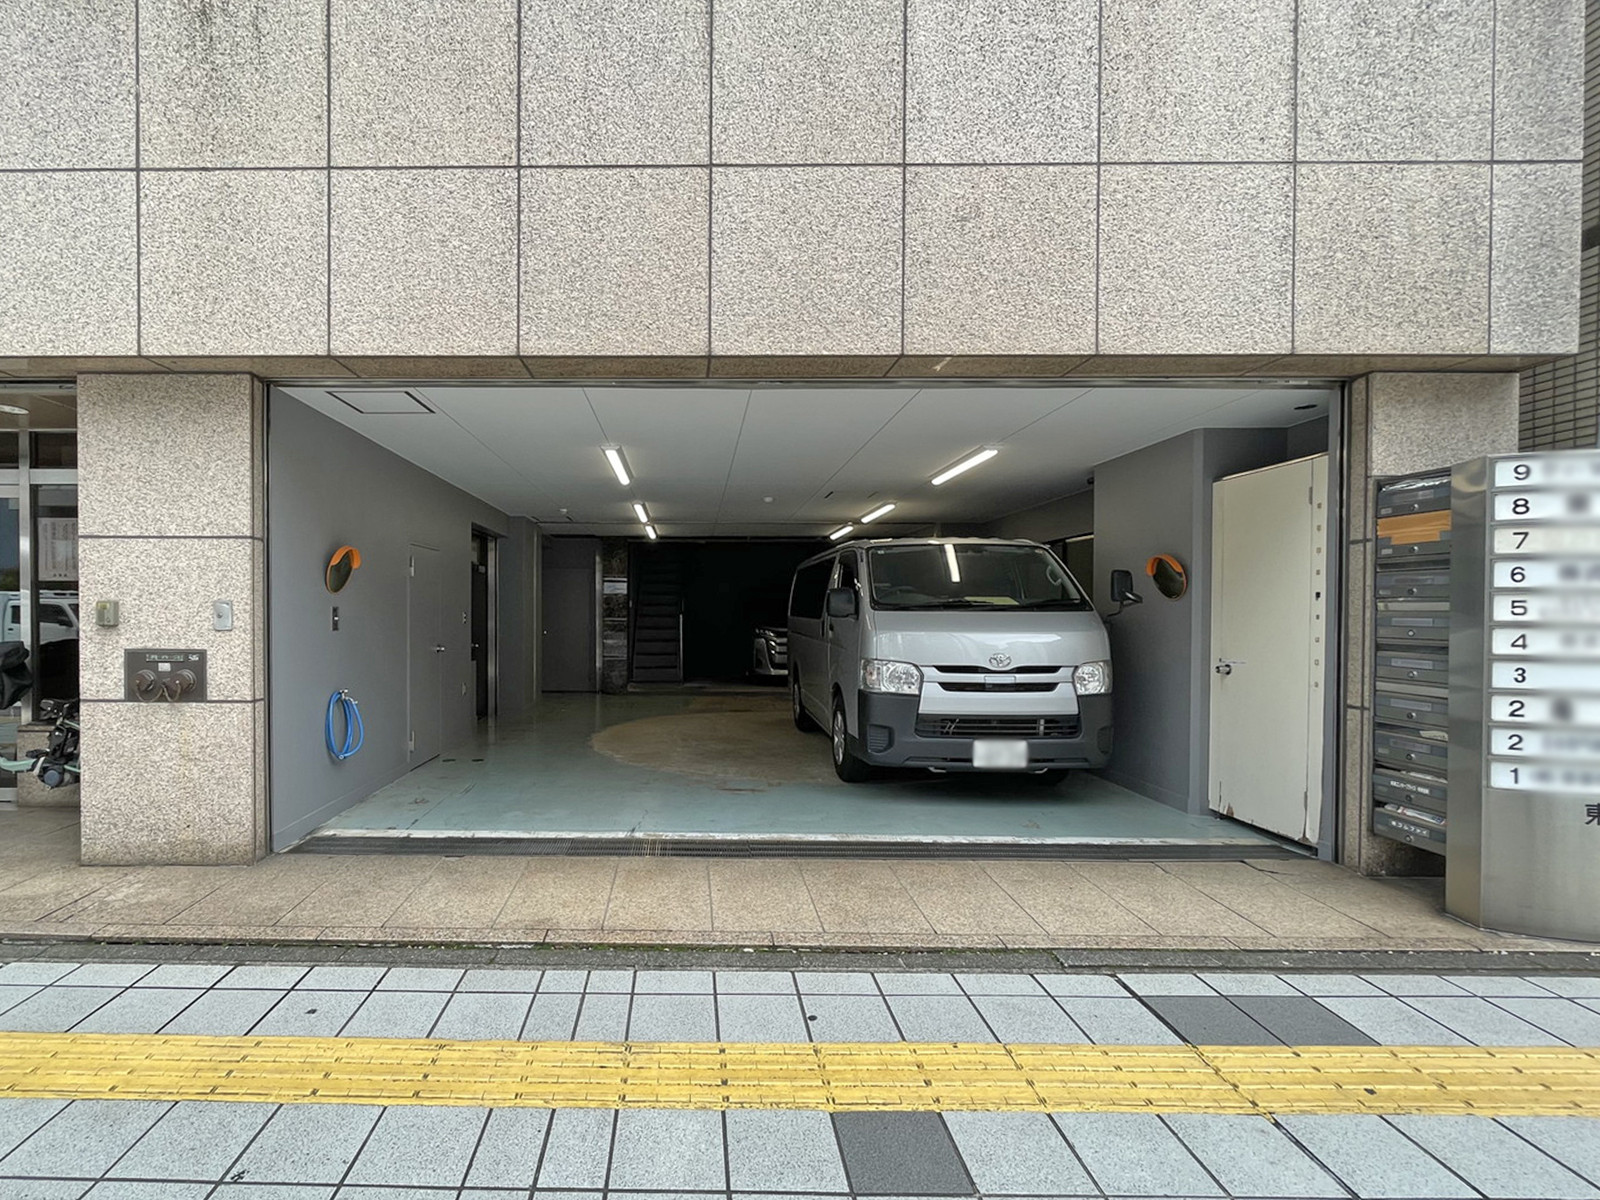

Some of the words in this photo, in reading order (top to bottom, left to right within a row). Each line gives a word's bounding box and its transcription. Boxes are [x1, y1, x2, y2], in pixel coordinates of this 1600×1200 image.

[1514, 465, 1531, 480] 9
[1512, 498, 1530, 514] 8
[1512, 532, 1529, 549] 7
[1510, 567, 1526, 582] 6
[1510, 600, 1527, 616] 5
[1510, 634, 1527, 649] 4
[1513, 668, 1526, 683] 3
[1508, 700, 1525, 717] 2
[1507, 734, 1523, 750] 2
[1509, 768, 1519, 784] 1
